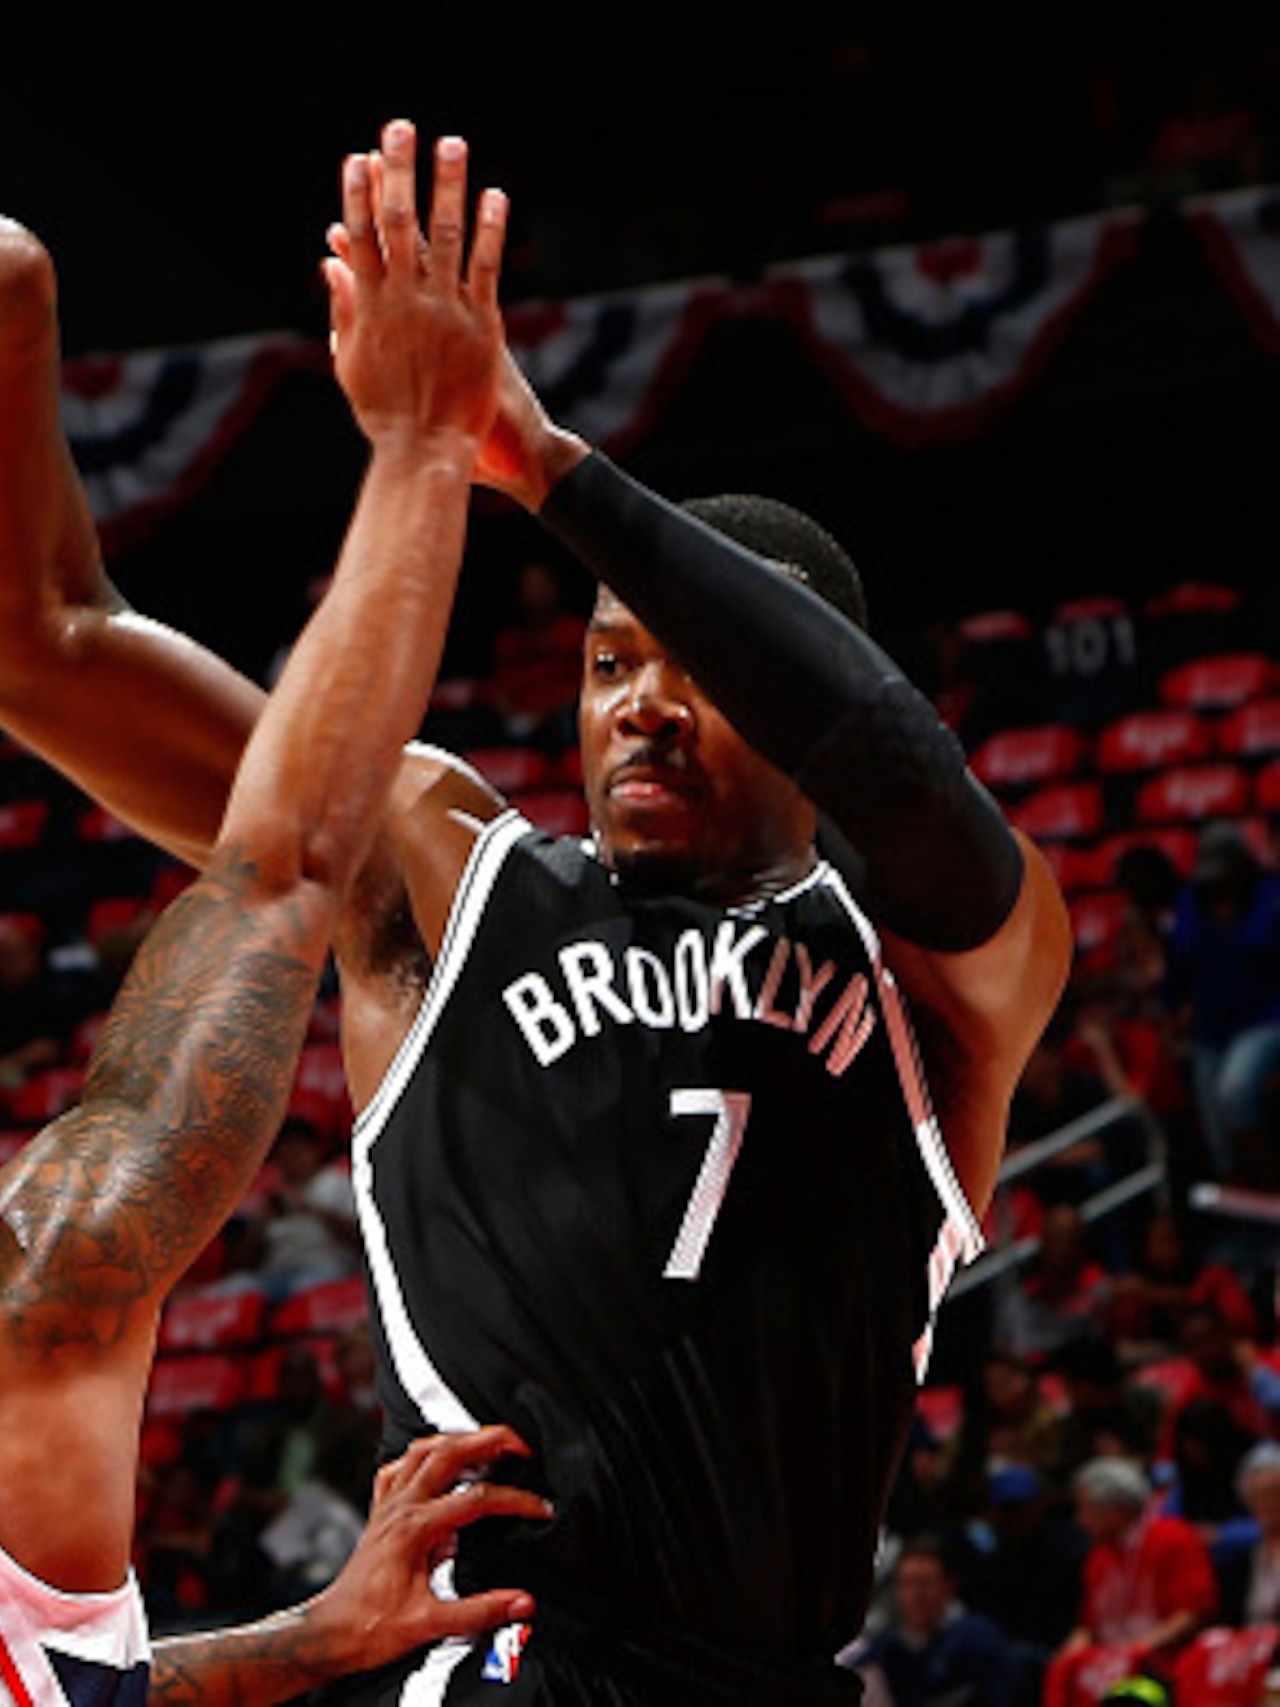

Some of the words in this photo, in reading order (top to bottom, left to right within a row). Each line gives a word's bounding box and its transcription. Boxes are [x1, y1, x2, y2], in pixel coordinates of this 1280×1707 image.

[1044, 615, 1136, 677] 101
[502, 921, 876, 1076] BROOKLYN
[661, 1088, 752, 1280] 7
